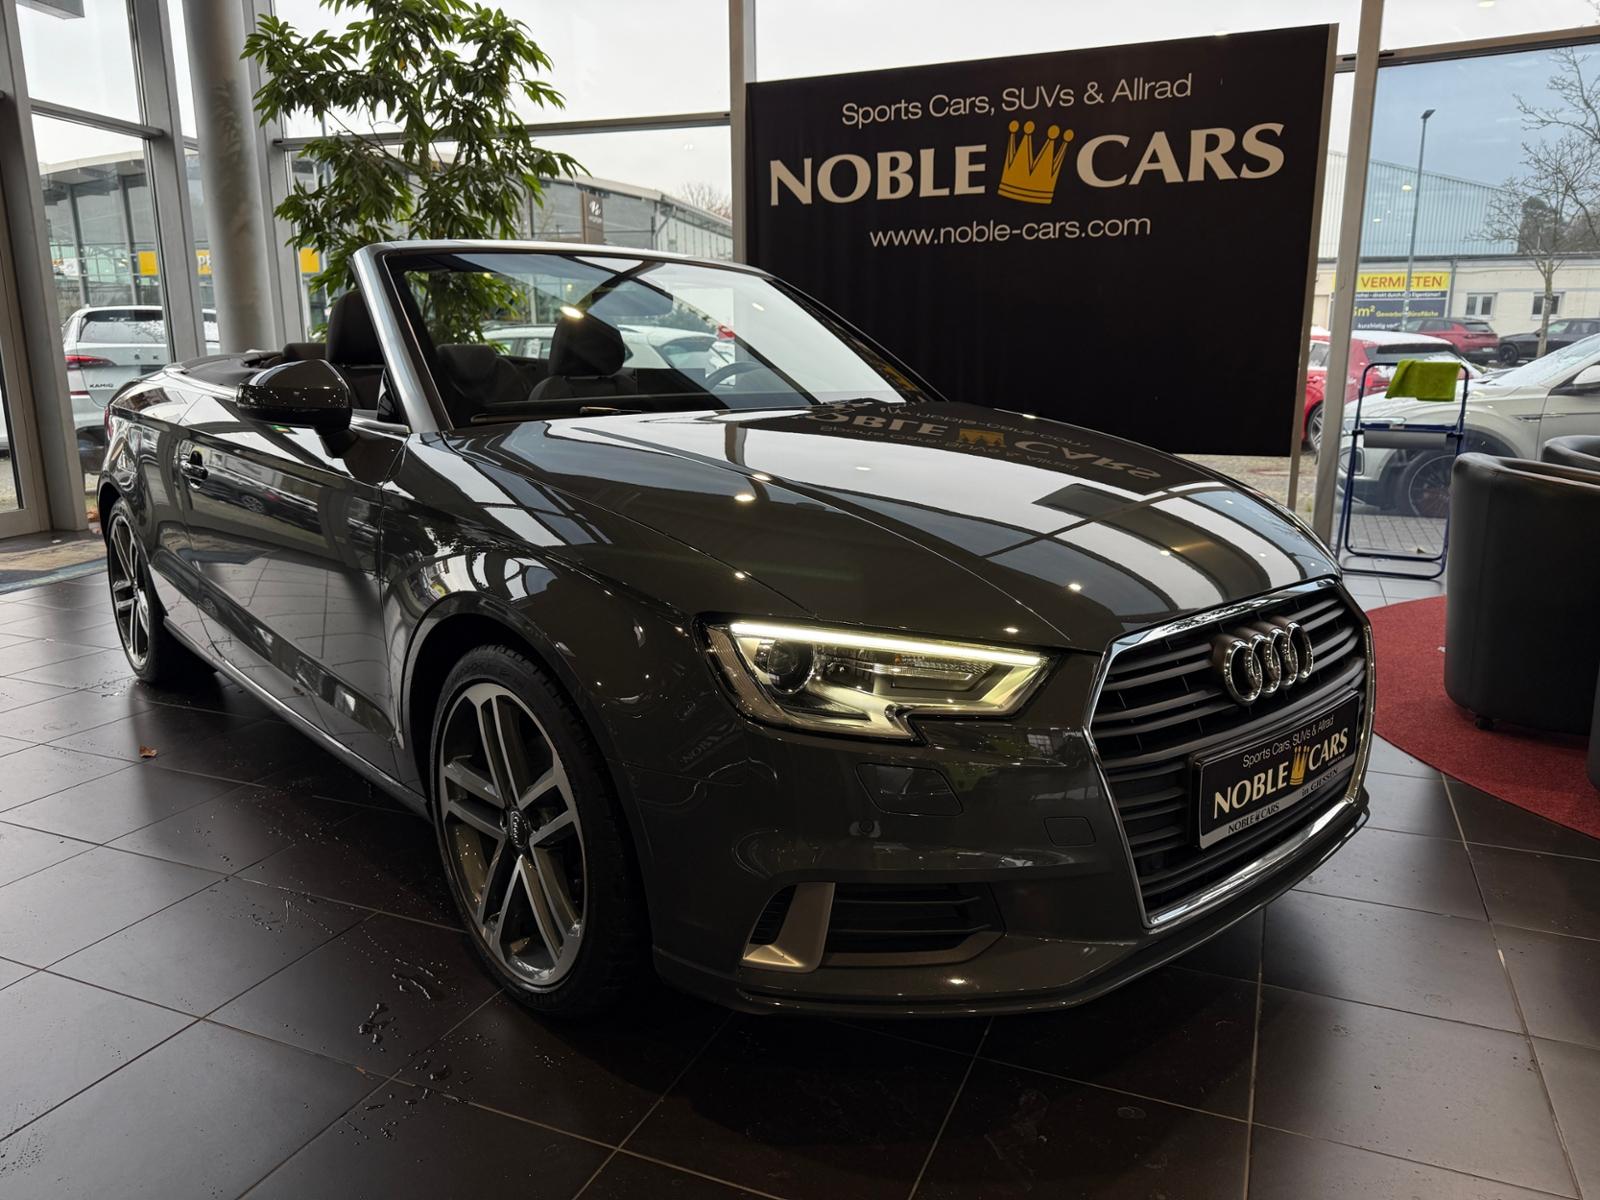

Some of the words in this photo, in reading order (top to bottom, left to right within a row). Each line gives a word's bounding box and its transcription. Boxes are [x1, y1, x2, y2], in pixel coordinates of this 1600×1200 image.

[842, 99, 922, 130] Sports
[929, 94, 995, 116] Cars,
[1001, 84, 1075, 111] SUVs
[1083, 81, 1104, 105] &
[1111, 73, 1192, 103] Allrad
[769, 144, 987, 206] NOBLE
[1076, 122, 1285, 188] CARS
[869, 217, 1151, 247] www.noble-cars.com
[1242, 747, 1271, 768] Sports
[1272, 740, 1292, 756] Cars,
[1311, 724, 1317, 736] &
[1317, 714, 1335, 733] Allrad
[1213, 761, 1289, 819] NOBLE
[1308, 727, 1348, 771] CARS
[1227, 812, 1256, 834] NOBLE
[1259, 802, 1280, 820] CARS
